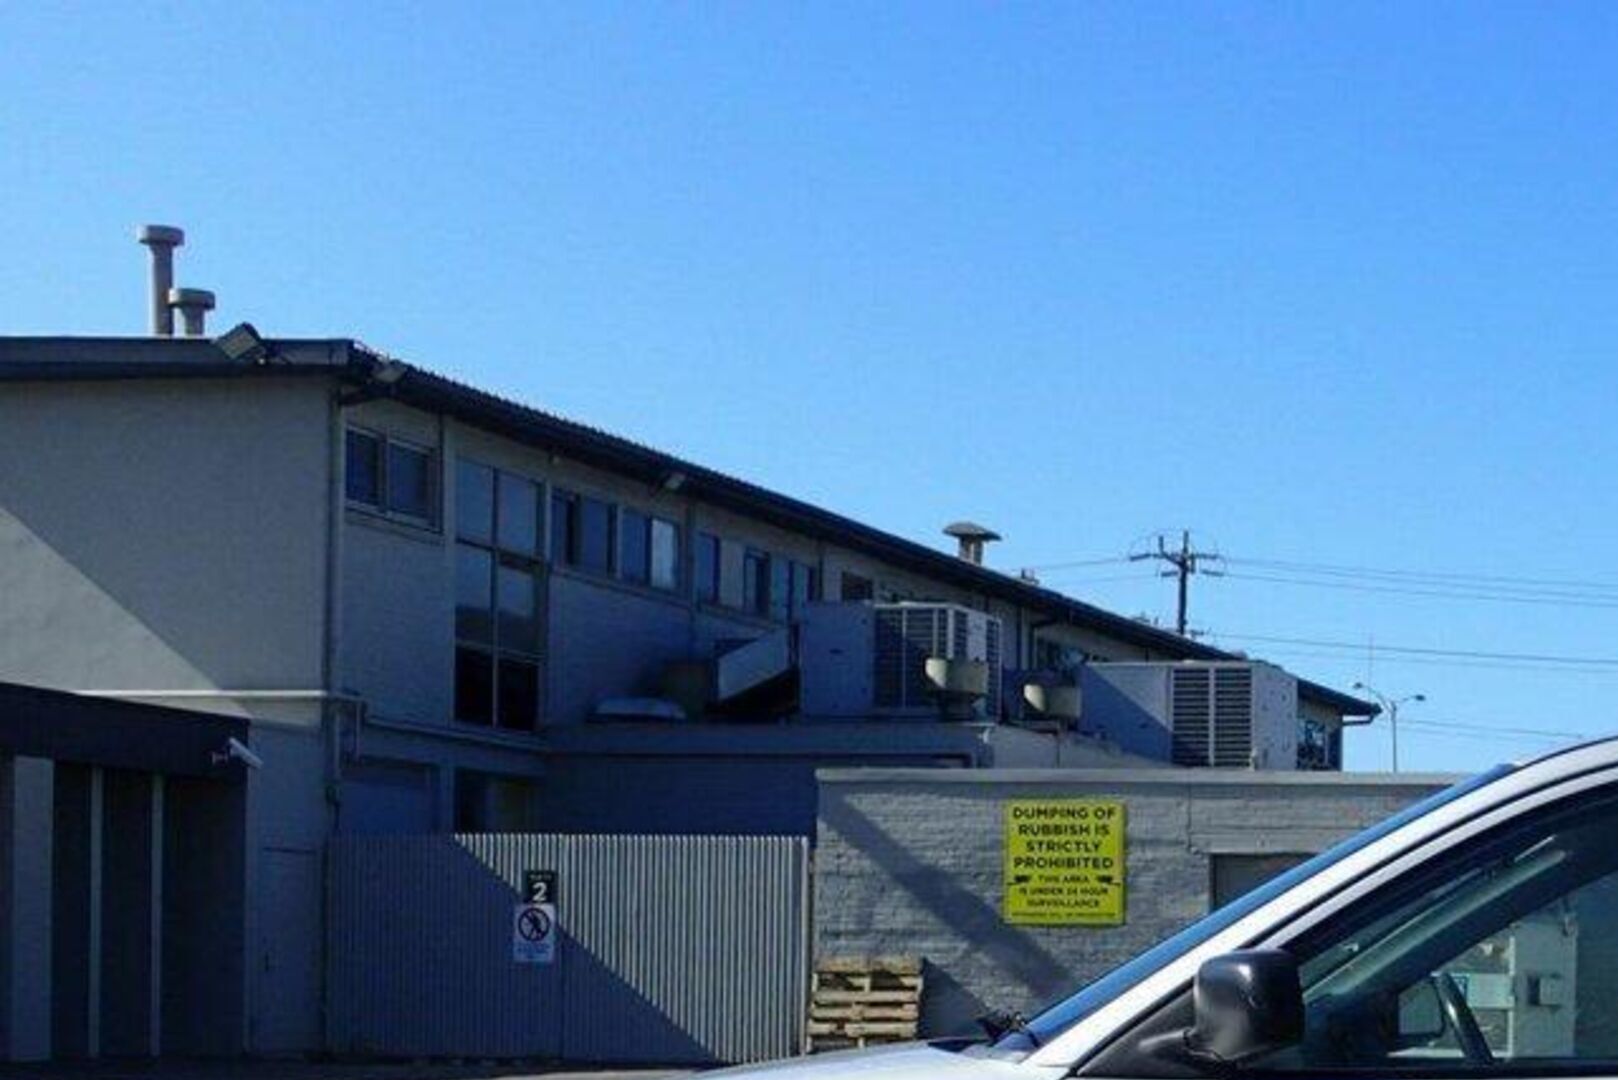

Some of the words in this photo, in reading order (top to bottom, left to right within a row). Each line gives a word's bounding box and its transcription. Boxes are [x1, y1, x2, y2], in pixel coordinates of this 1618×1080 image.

[1013, 806, 1088, 820] DUMPING
[1094, 806, 1117, 820] OF
[1018, 823, 1090, 836] RUBBISH
[1094, 823, 1110, 836] IS
[1026, 840, 1102, 853] STRICTLY
[1013, 857, 1114, 869] PROHIBITED
[532, 882, 547, 902] 2
